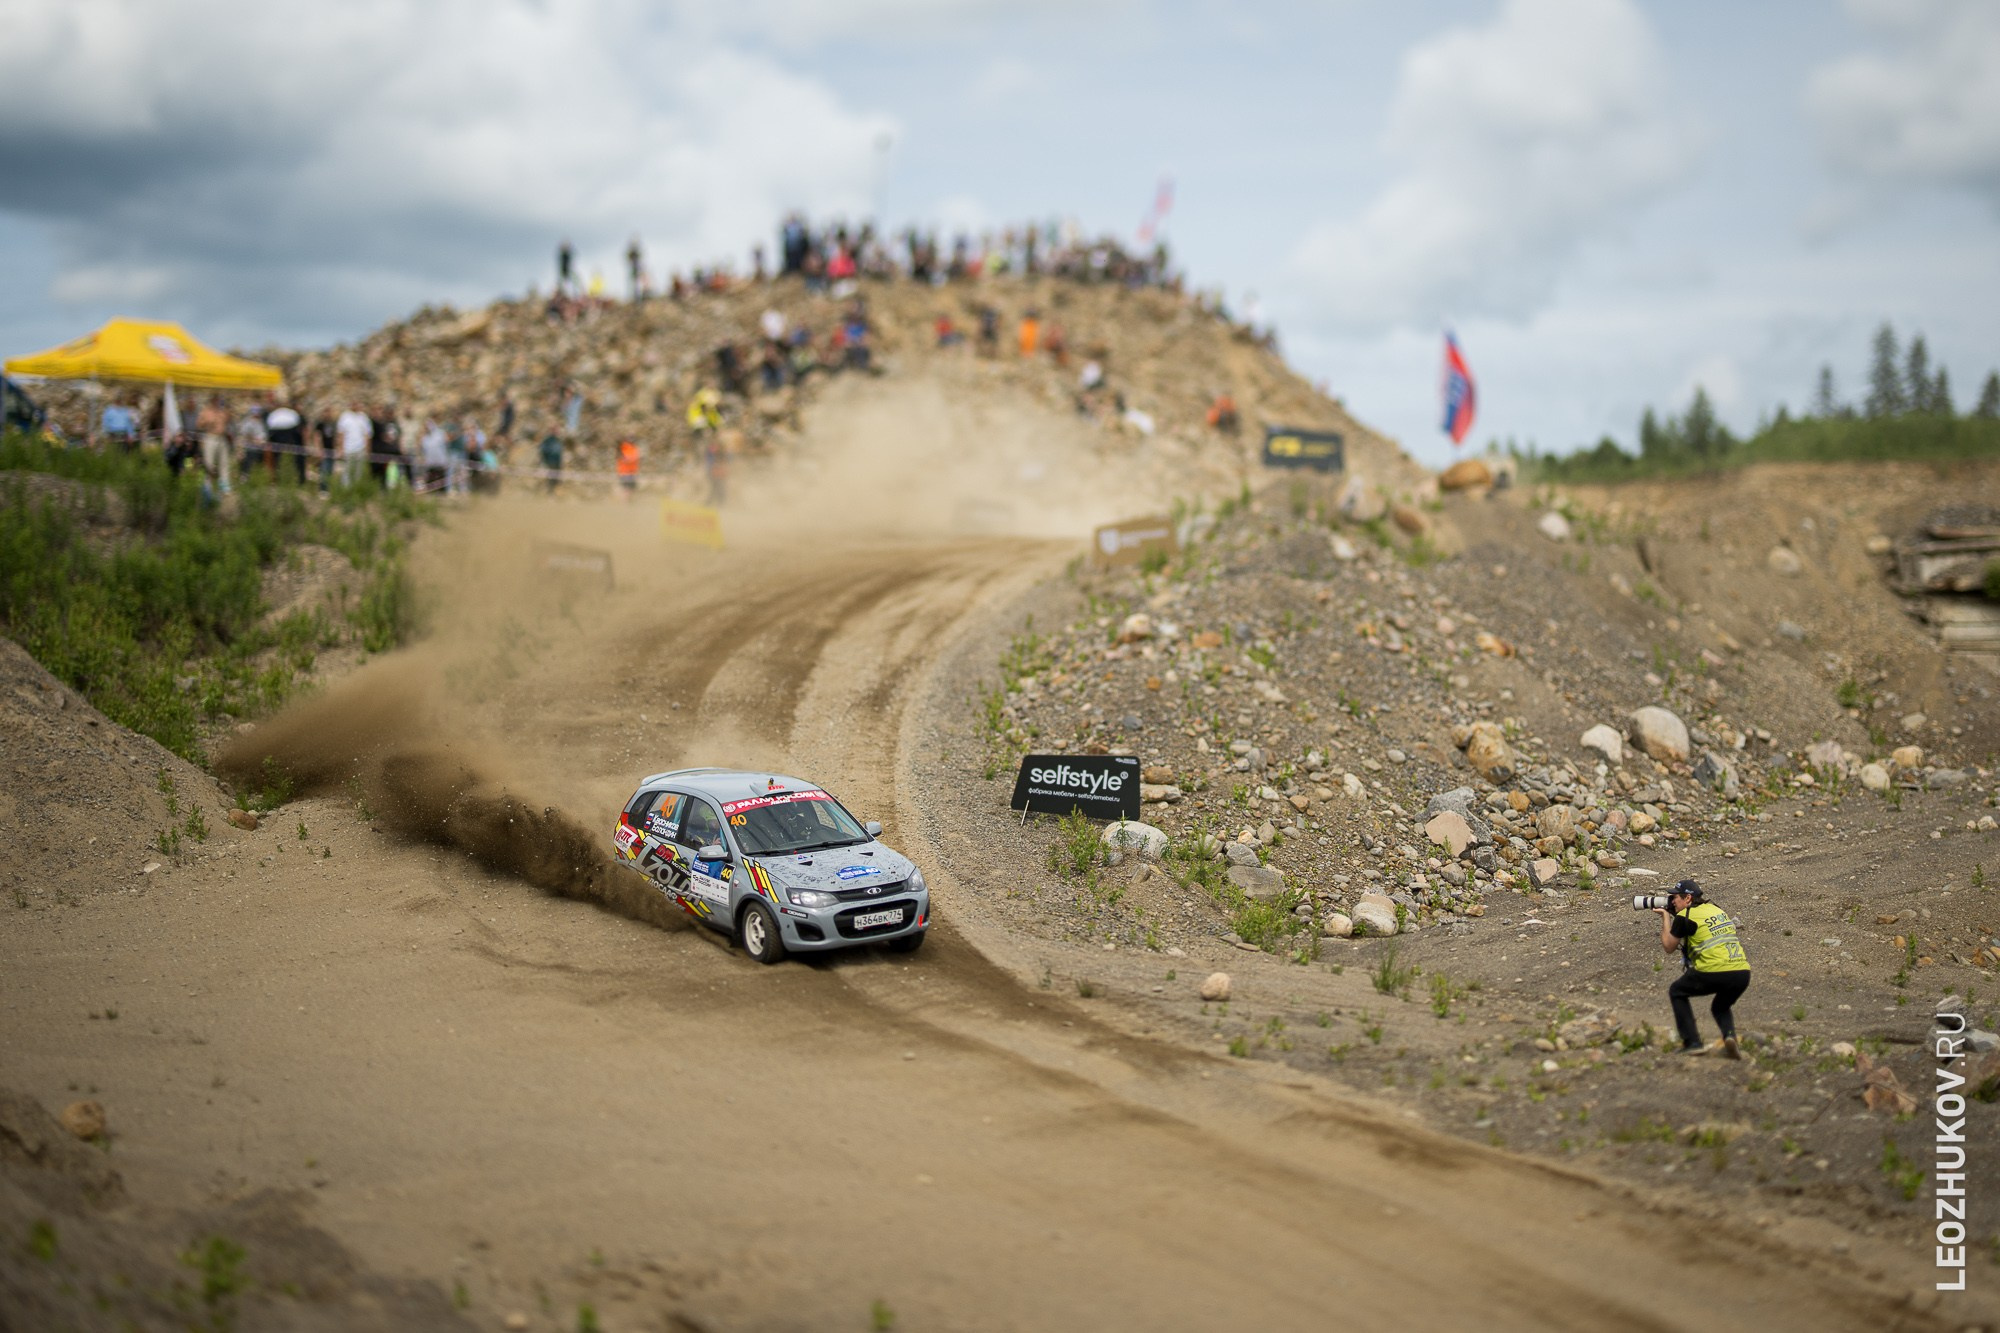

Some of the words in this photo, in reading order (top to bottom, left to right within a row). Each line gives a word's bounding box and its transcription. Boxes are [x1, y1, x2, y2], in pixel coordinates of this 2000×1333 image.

[1028, 787, 1053, 796] фабрика
[1053, 789, 1075, 798] мебели
[660, 795, 677, 818] 40
[736, 797, 774, 809] РАЛЛИ
[730, 814, 747, 826] 40
[721, 867, 733, 880] 40
[1725, 943, 1743, 959] 12
